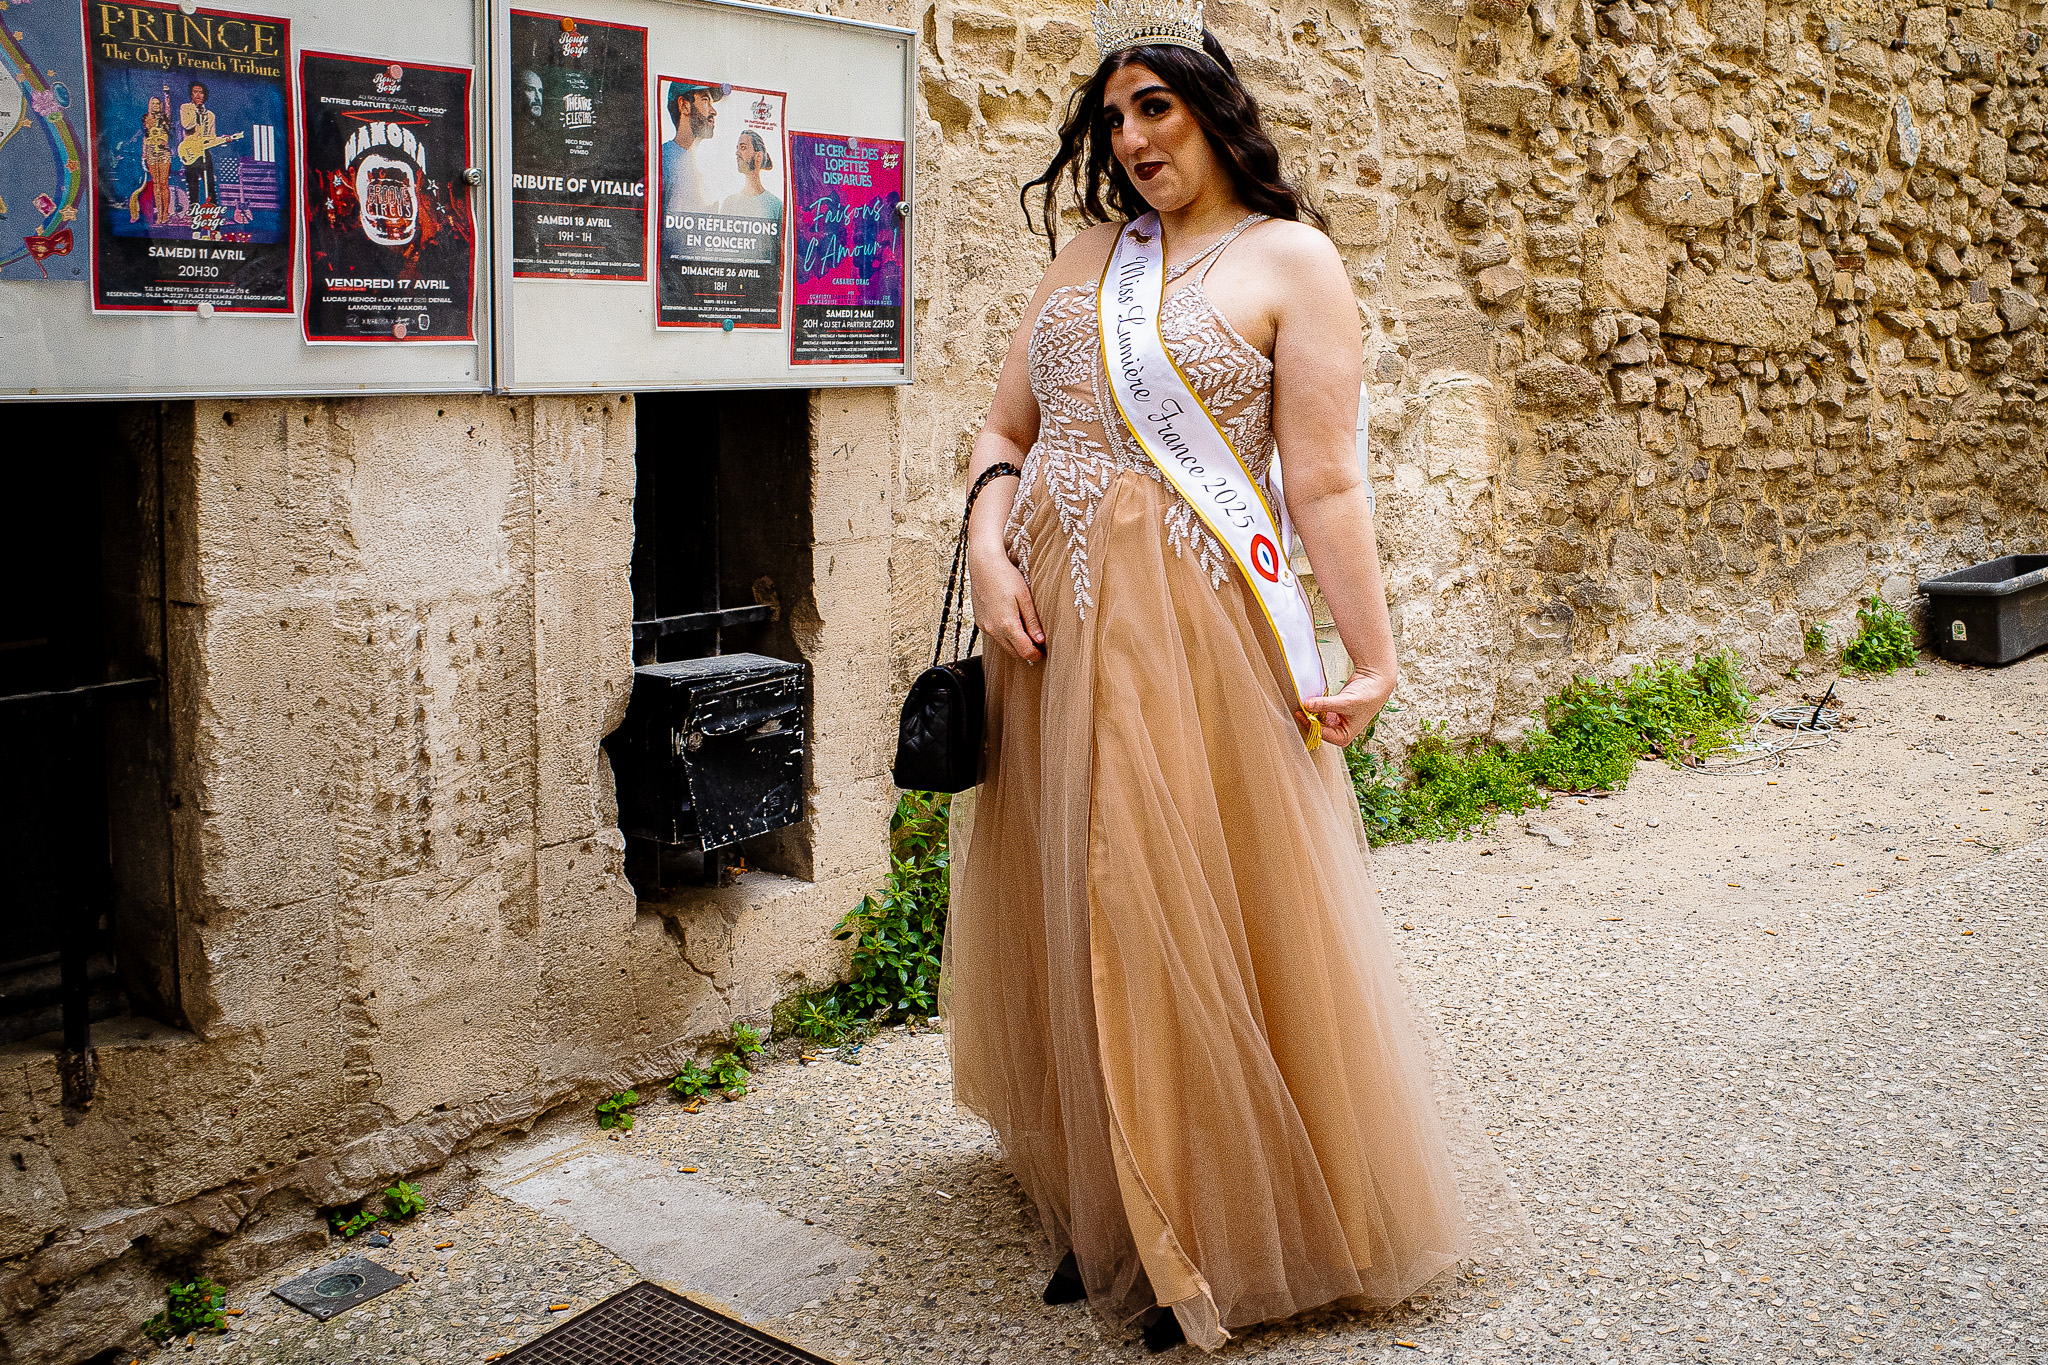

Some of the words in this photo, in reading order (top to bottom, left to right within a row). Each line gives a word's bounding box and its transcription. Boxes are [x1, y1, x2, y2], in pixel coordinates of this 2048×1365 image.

[97, 3, 278, 56] PRINCE
[559, 32, 589, 47] Rouge
[562, 43, 588, 58] Gorge
[102, 43, 131, 60] The
[136, 47, 173, 69] Only
[178, 52, 226, 71] French
[230, 58, 280, 77] Tribute
[376, 82, 402, 94] Gorge
[352, 100, 391, 109] GRATUITE
[815, 143, 825, 156] LE
[827, 144, 860, 158] CERCLE
[861, 148, 879, 160] DES
[825, 158, 869, 173] LOPETTES
[512, 174, 563, 191] RIBUTE
[566, 178, 587, 192] OF
[591, 179, 645, 197] VITALIC
[823, 172, 872, 187] DISPARUES
[186, 202, 228, 219] Rouge
[367, 203, 411, 217] CIRCUS
[809, 196, 884, 232] Faisons
[190, 214, 226, 230] Gorge
[537, 214, 573, 226] SAMEDI
[574, 216, 584, 227] 18
[586, 217, 612, 228] AVRIL
[665, 215, 694, 230] DUO
[697, 215, 778, 236] RÉFLECTIONS
[558, 231, 574, 241] 19H
[582, 232, 592, 242] 1H
[686, 234, 702, 246] EN
[704, 236, 757, 249] CONCERT
[148, 246, 196, 258] SAMEDI
[199, 248, 208, 259] 11
[211, 249, 246, 260] AVRIL
[178, 265, 219, 278] 20H30
[681, 266, 724, 276] DIMANCHE
[726, 268, 736, 277] 26
[738, 269, 760, 278] AVRIL
[325, 278, 395, 289] VENDREDI
[397, 279, 411, 289] 17
[414, 280, 450, 289] AVRIL
[714, 282, 728, 291] 18H
[1118, 256, 1149, 305] Miss
[826, 310, 853, 318] SAMEDI
[854, 310, 859, 318] 2
[860, 310, 874, 318] MAI
[803, 319, 819, 328] 20H
[872, 319, 894, 328] 22H30
[1117, 305, 1151, 402] Lumière
[1147, 399, 1205, 478] France
[1202, 477, 1255, 528] 2025
